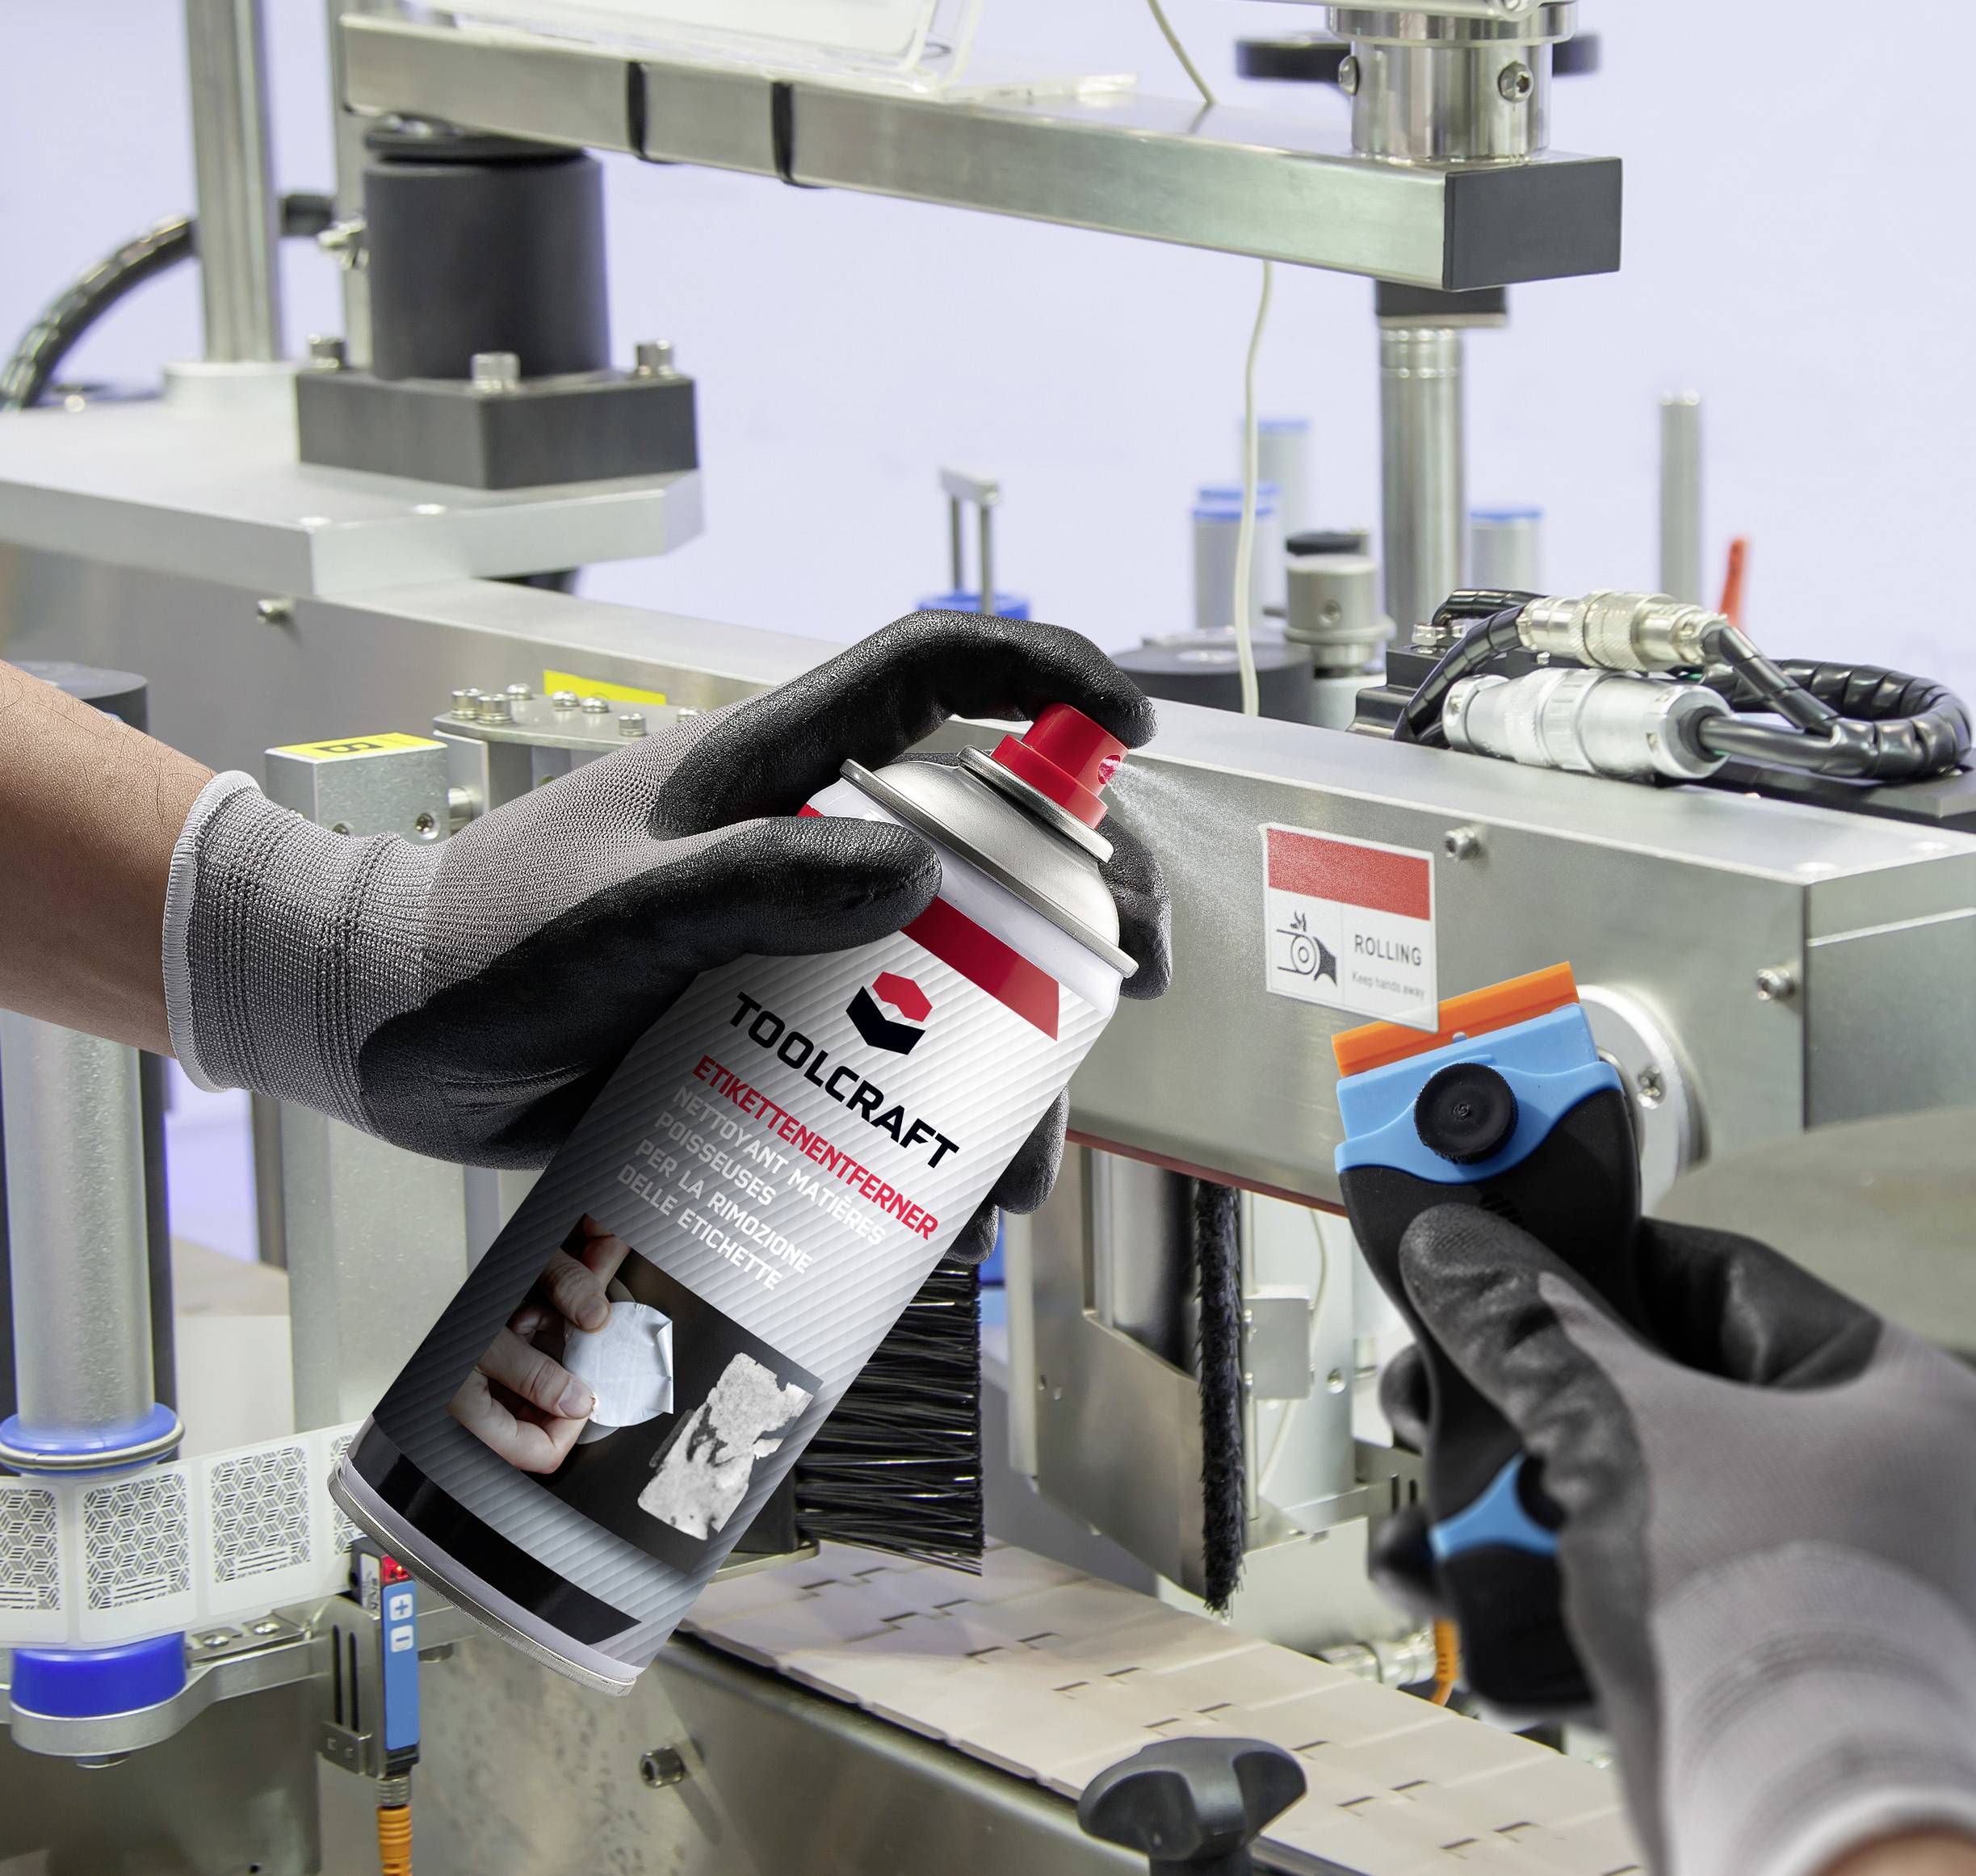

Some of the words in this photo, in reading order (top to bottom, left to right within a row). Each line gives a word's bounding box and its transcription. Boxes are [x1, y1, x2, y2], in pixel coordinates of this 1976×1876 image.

[1354, 934, 1422, 967] ROLLING
[730, 991, 959, 1169] TOOLCRAFT
[635, 1139, 678, 1178] PER
[678, 1169, 706, 1196] LA
[707, 1192, 814, 1274] RIMOZIONE
[654, 1110, 777, 1207] POISSEUSES
[672, 1085, 789, 1177] NETTOYANT
[789, 1168, 884, 1244] MATIÈRES
[692, 1055, 939, 1241] ETIKETTENENTFERNER
[616, 1163, 678, 1218] DELLE
[677, 1210, 783, 1291] ETICHETTE
